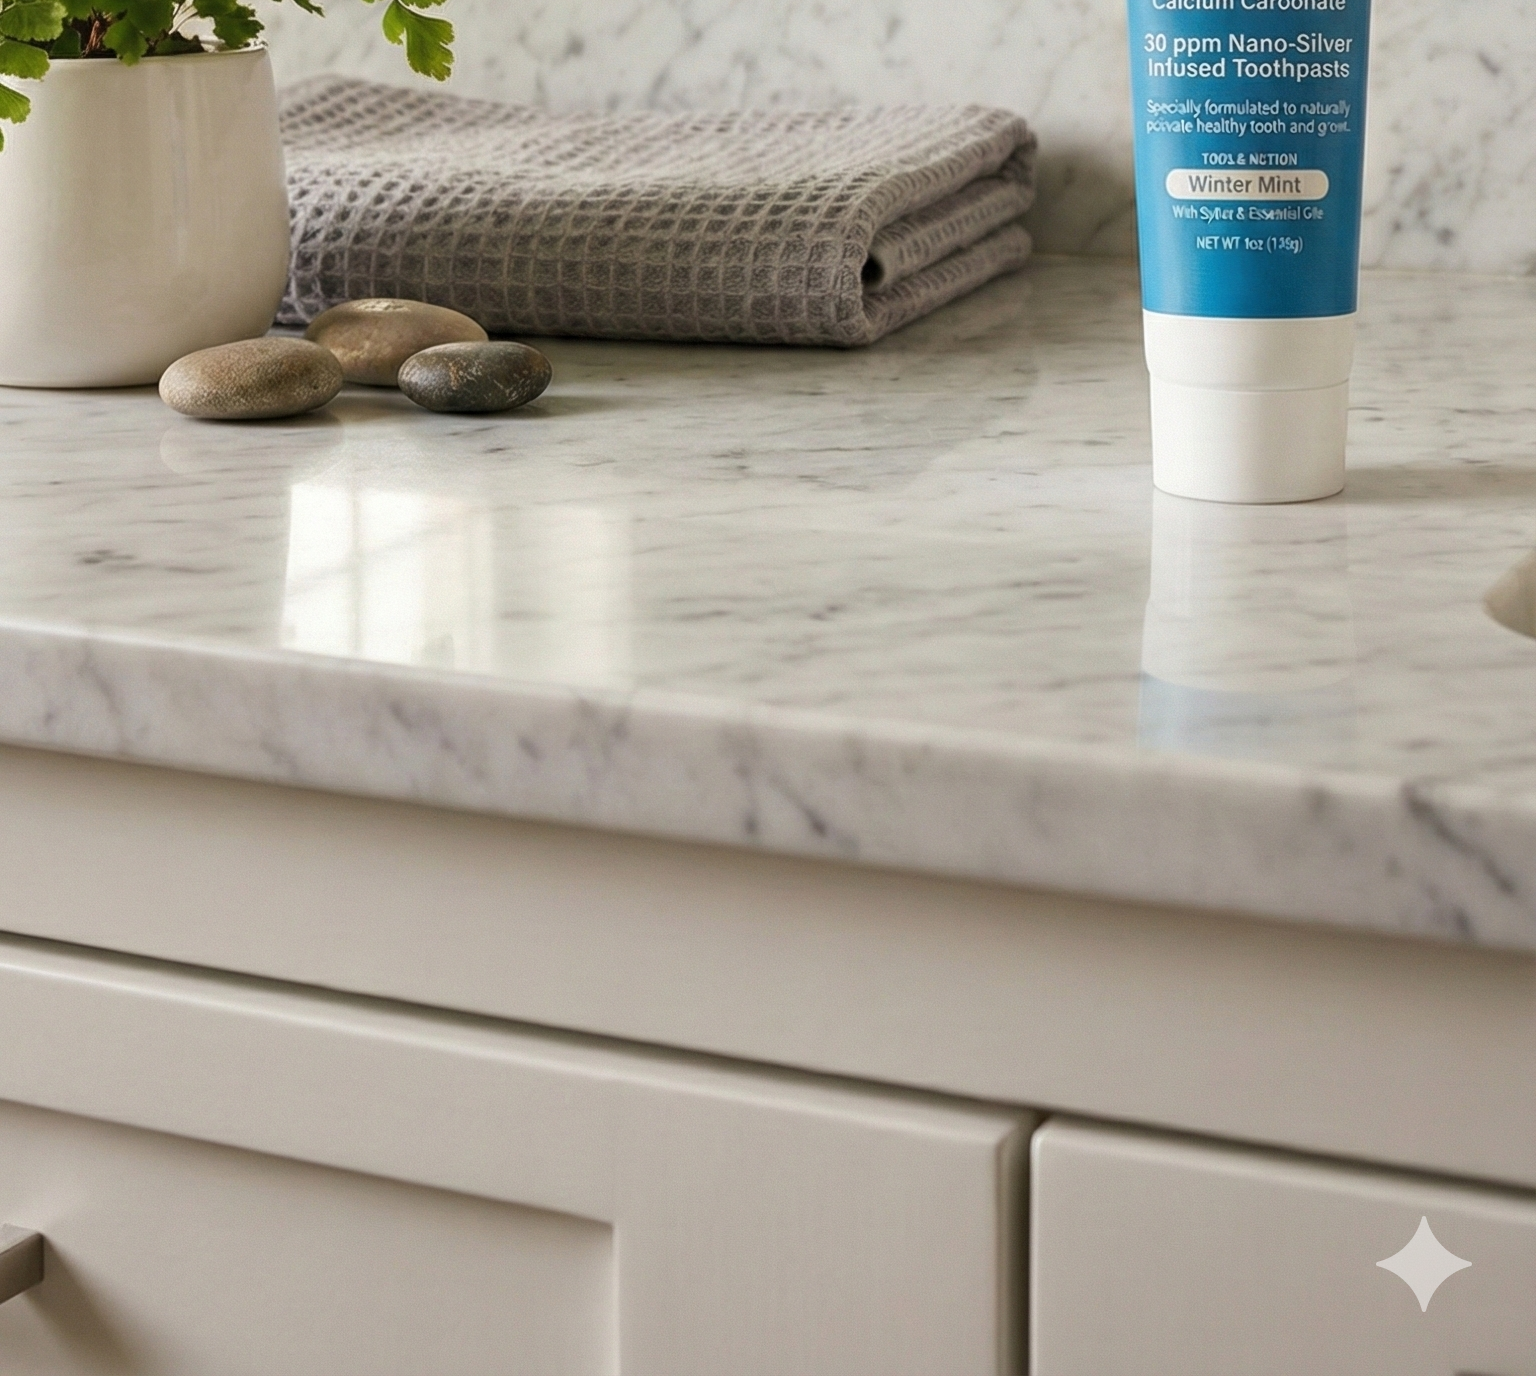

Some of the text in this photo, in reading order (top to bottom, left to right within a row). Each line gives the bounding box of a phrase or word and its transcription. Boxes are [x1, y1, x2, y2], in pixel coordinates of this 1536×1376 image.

[1144, 34, 1352, 57] 30 ppm Nano-Silver
[1148, 58, 1350, 82] Infused Toothpasts
[1205, 99, 1279, 115] formulated
[1283, 102, 1297, 115] to
[1300, 100, 1350, 118] naturally
[1196, 118, 1246, 137] healthy
[1250, 119, 1286, 133] tooth
[1290, 120, 1314, 133] and
[1188, 175, 1301, 193] Winter Mint
[1196, 236, 1219, 249] NET
[1222, 236, 1240, 249] WT
